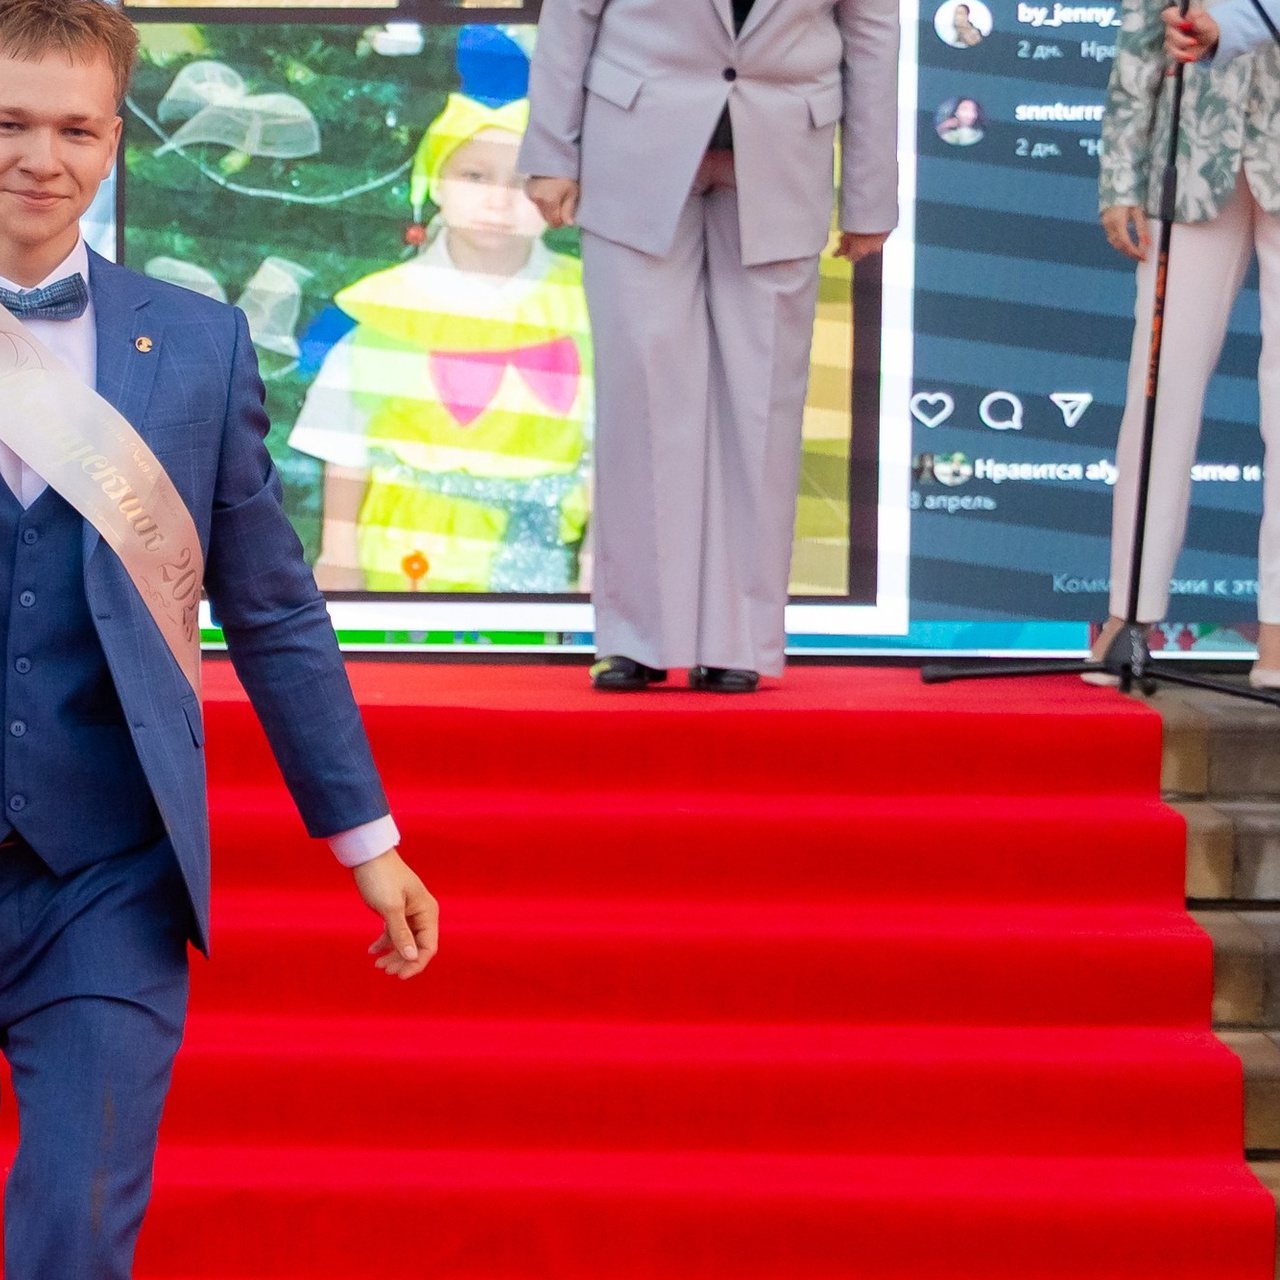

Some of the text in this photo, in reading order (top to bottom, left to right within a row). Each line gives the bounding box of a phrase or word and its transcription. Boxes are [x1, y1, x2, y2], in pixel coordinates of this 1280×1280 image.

[1017, 40, 1031, 58] 2
[1015, 138, 1029, 156] 2
[974, 458, 1083, 484] Нравится
